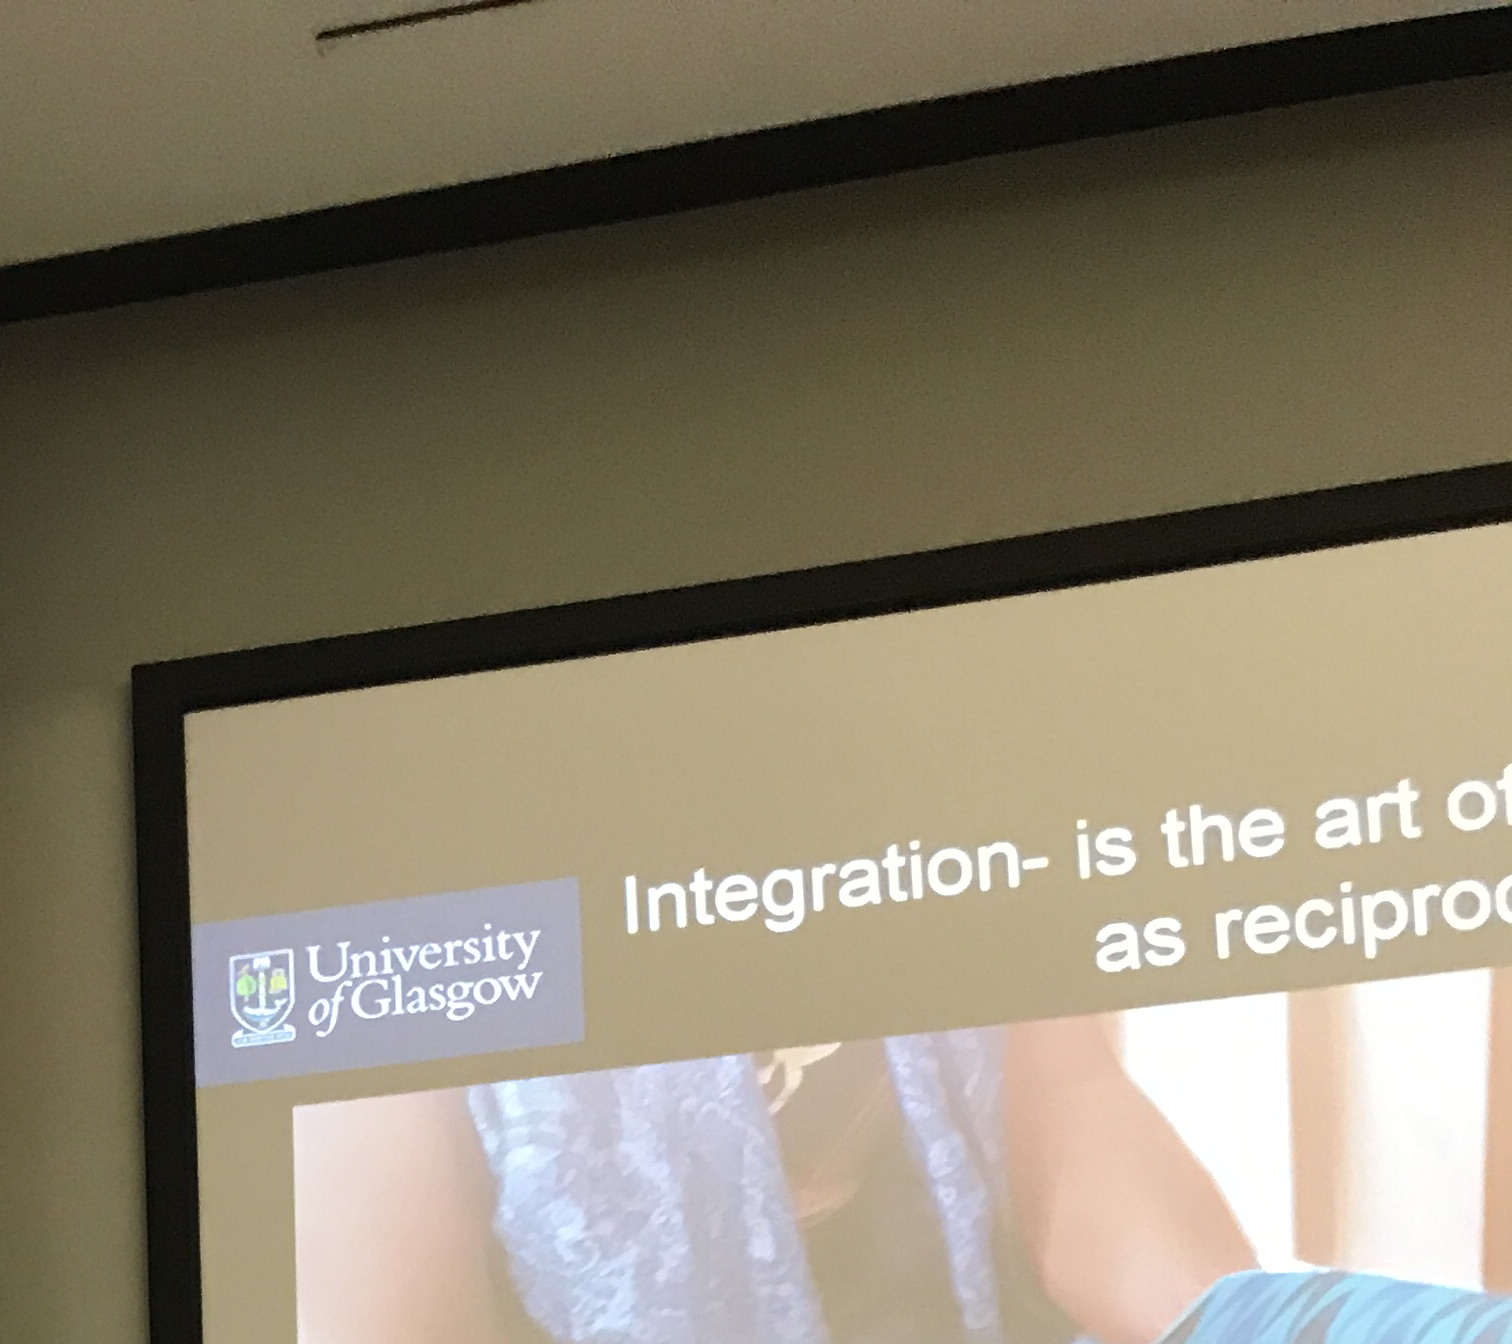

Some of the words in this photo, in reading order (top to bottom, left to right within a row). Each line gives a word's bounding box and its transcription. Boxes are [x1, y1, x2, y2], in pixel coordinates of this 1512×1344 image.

[625, 840, 1049, 934] Integration-
[1076, 819, 1137, 879] is
[1161, 804, 1286, 868] the
[1315, 778, 1422, 849] art
[305, 923, 541, 983] University
[1096, 917, 1186, 973] as
[308, 981, 352, 1037] of
[351, 971, 543, 1021] Glasgow
